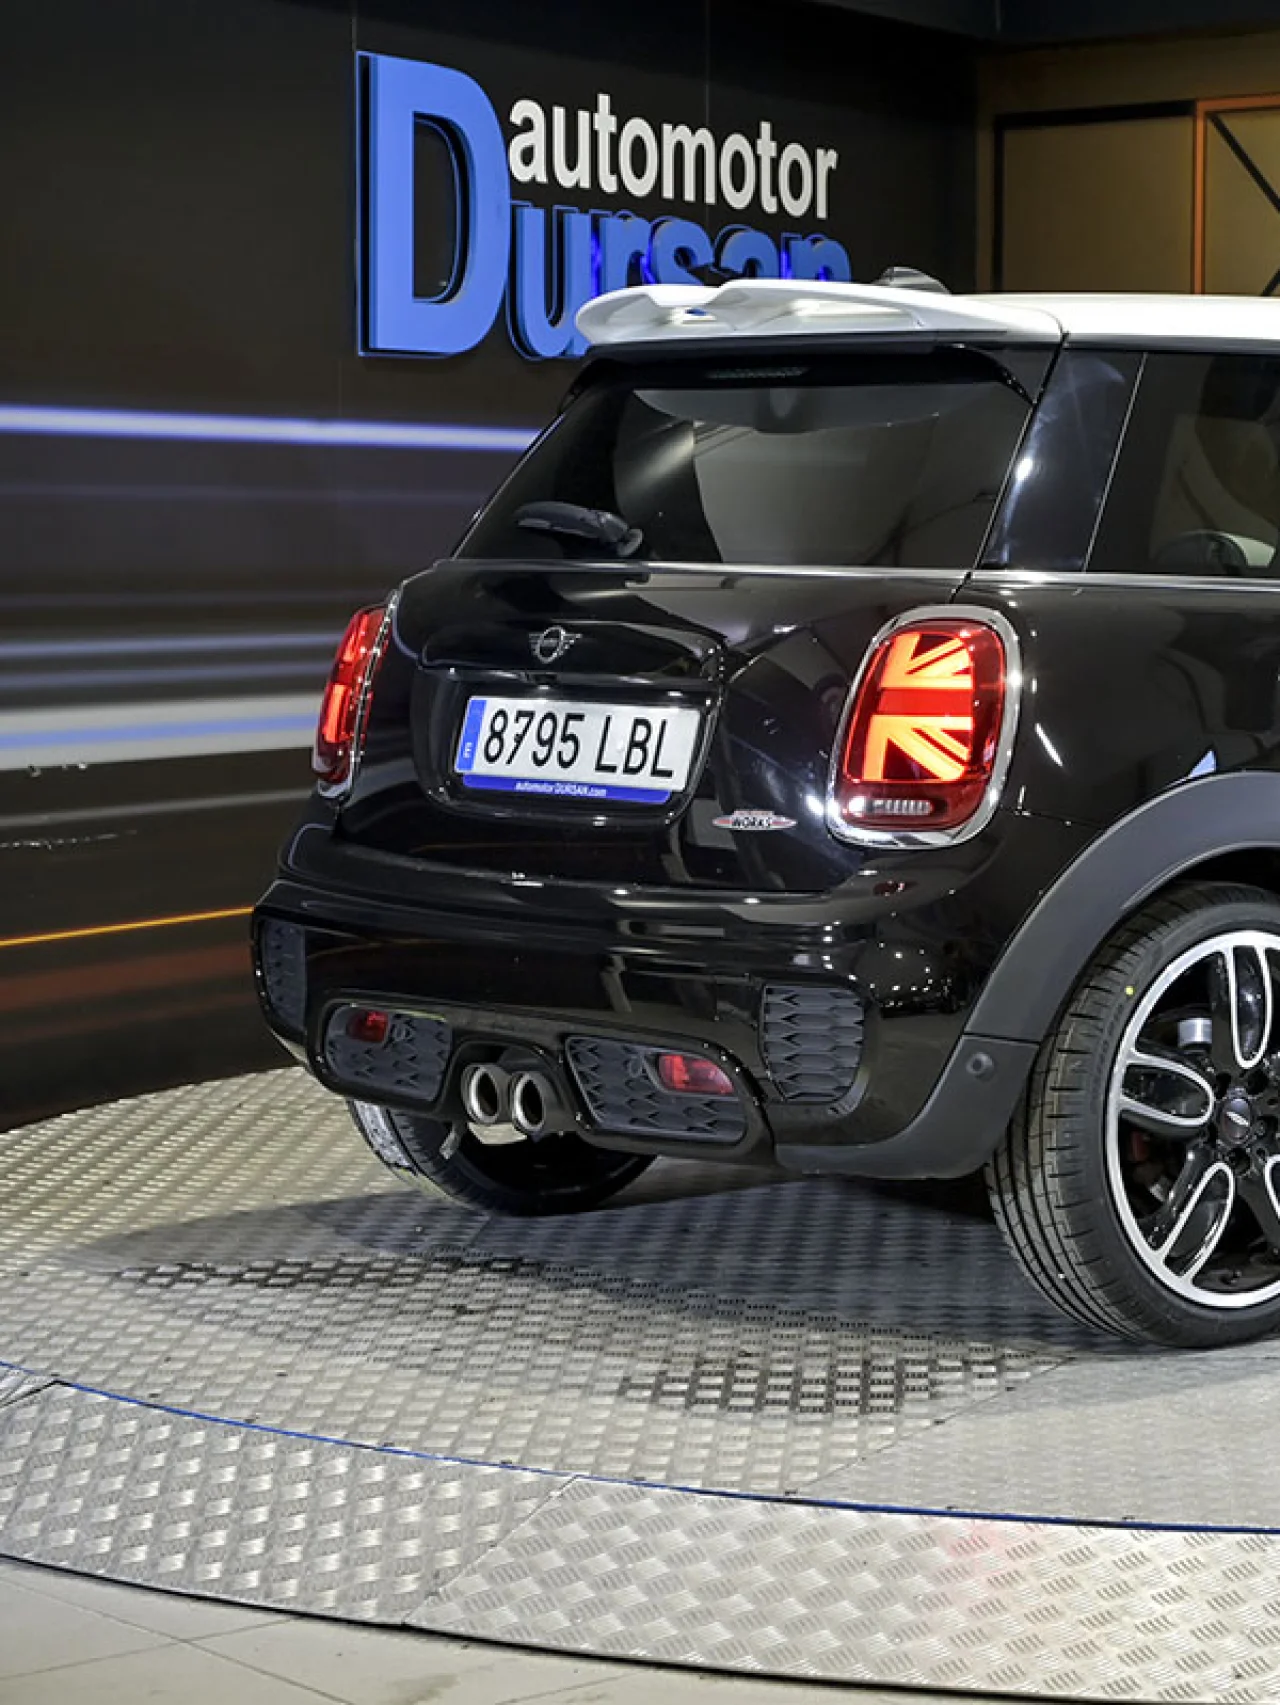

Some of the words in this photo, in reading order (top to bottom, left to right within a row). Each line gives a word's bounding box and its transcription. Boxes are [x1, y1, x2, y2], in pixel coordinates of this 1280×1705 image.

[509, 93, 837, 218] automotor
[484, 708, 586, 768] 8795
[595, 715, 674, 778] LBL
